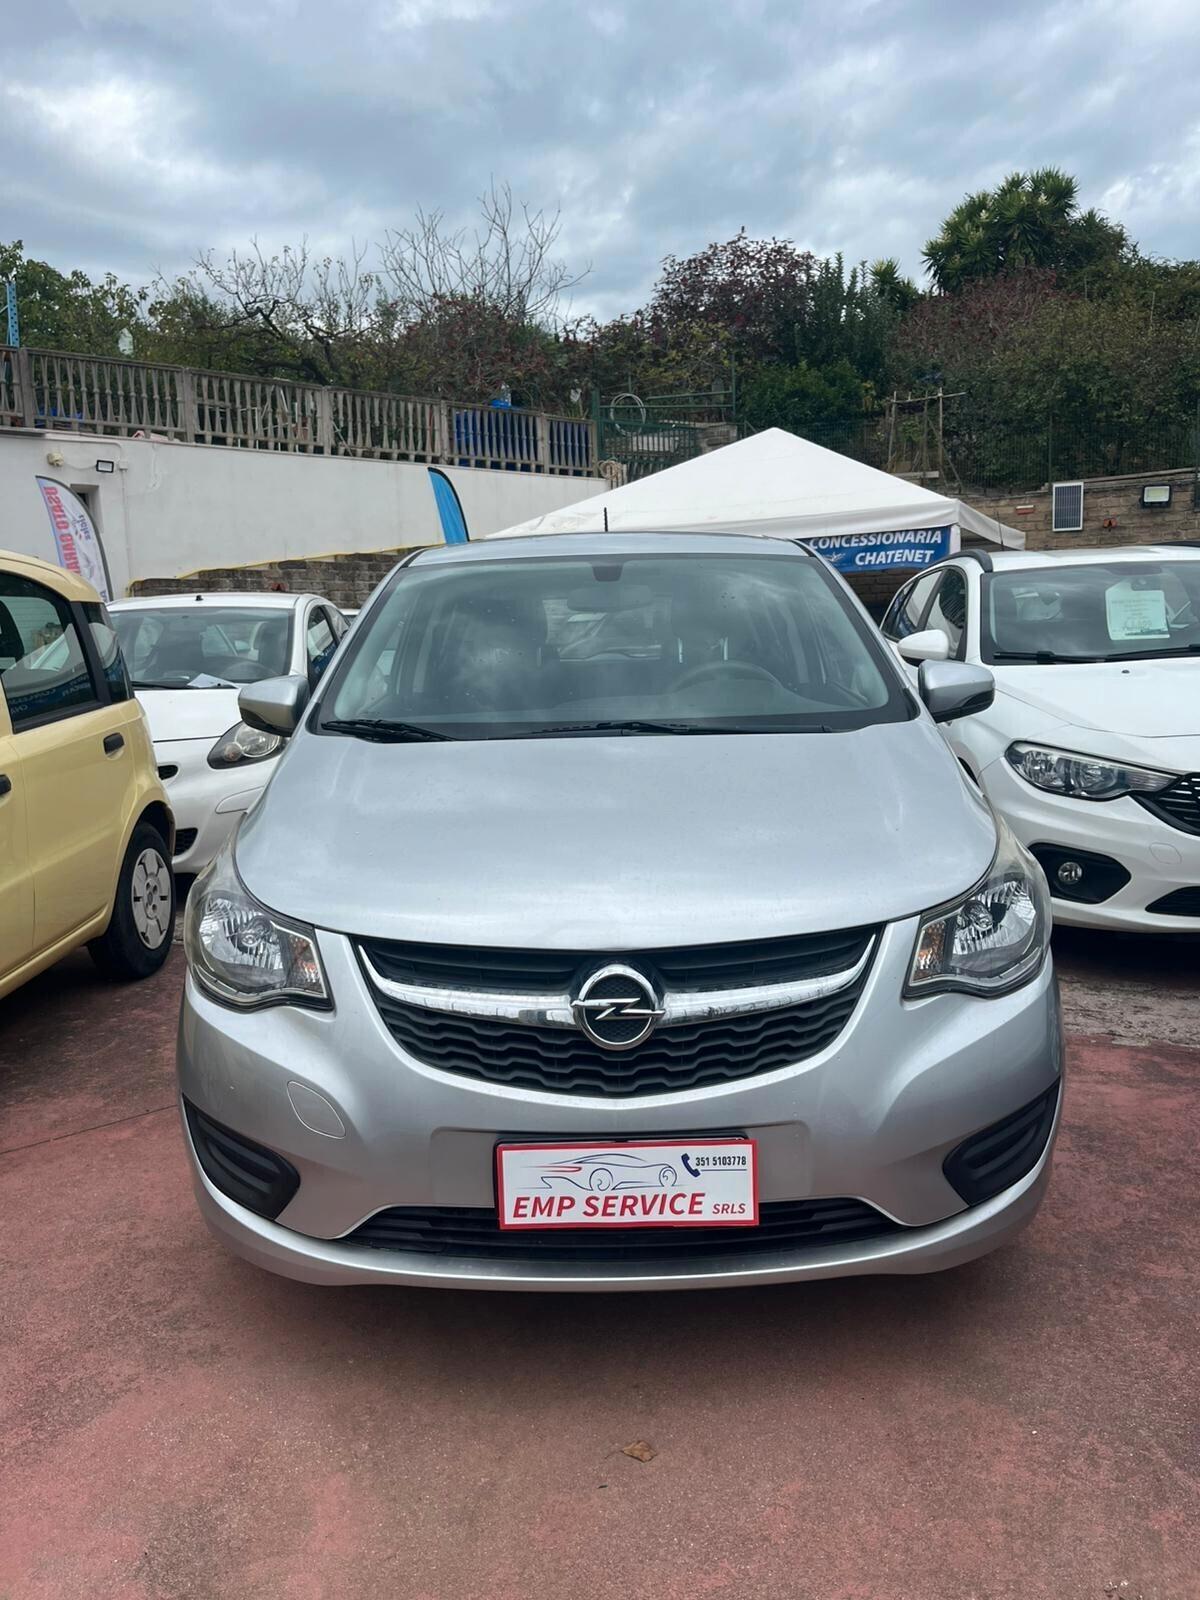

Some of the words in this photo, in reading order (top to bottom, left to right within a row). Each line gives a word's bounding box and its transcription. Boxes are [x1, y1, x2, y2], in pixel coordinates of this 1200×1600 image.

[809, 530, 942, 550] CONCESSIONARIA
[855, 549, 934, 566] CHATENET
[695, 1156, 710, 1167] 351
[712, 1155, 747, 1166] 5103778
[512, 1195, 576, 1219] EMP
[582, 1192, 706, 1217] SERVICE
[712, 1202, 747, 1215] SRLS
